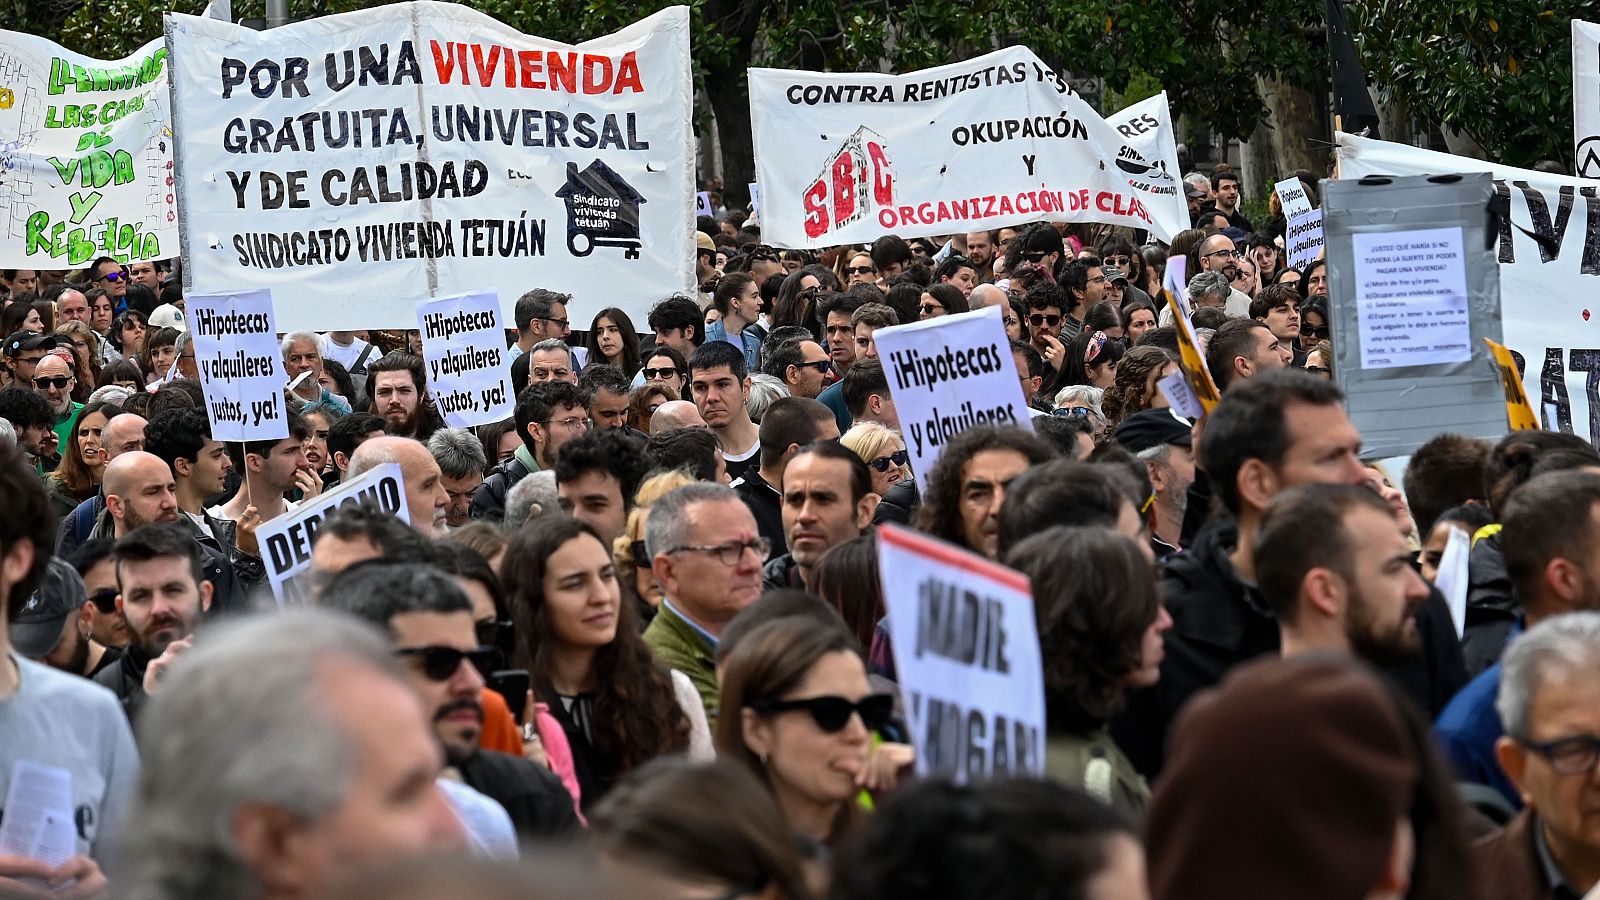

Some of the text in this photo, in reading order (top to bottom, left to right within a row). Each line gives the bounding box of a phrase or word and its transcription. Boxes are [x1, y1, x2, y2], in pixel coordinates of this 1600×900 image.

[222, 40, 644, 98] POR UNA VIVIENDA
[787, 85, 895, 105] CONTRA
[903, 62, 1026, 103] RENTISTAS
[44, 104, 97, 128] LAS
[223, 104, 650, 153] GRATUITA, UNIVERSAL
[951, 111, 1088, 146] OKUPACIÓN
[75, 125, 113, 151] DE
[46, 150, 135, 188] VIDA
[1022, 155, 1035, 176] Y
[226, 160, 489, 209] Y DE CALIDAD
[573, 194, 620, 207] Sindicato
[68, 191, 103, 224] Y
[879, 183, 1063, 228] ORGANIZACIÓN
[1069, 189, 1090, 210] DE
[26, 211, 160, 265] REBELDÍA
[233, 210, 546, 269] SINDICATO VIVIENDA TETUÁN
[1293, 236, 1324, 254] alquileres
[196, 308, 270, 340] ¡Hipotecas
[424, 309, 495, 340] ¡Hipotecas
[202, 350, 274, 384] y alquileres
[431, 346, 501, 382] y alquileres
[890, 343, 1002, 392] ¡Hipotecas
[210, 392, 278, 426] justos, ya!
[437, 380, 506, 417] justos, ya!
[910, 422, 922, 458] y
